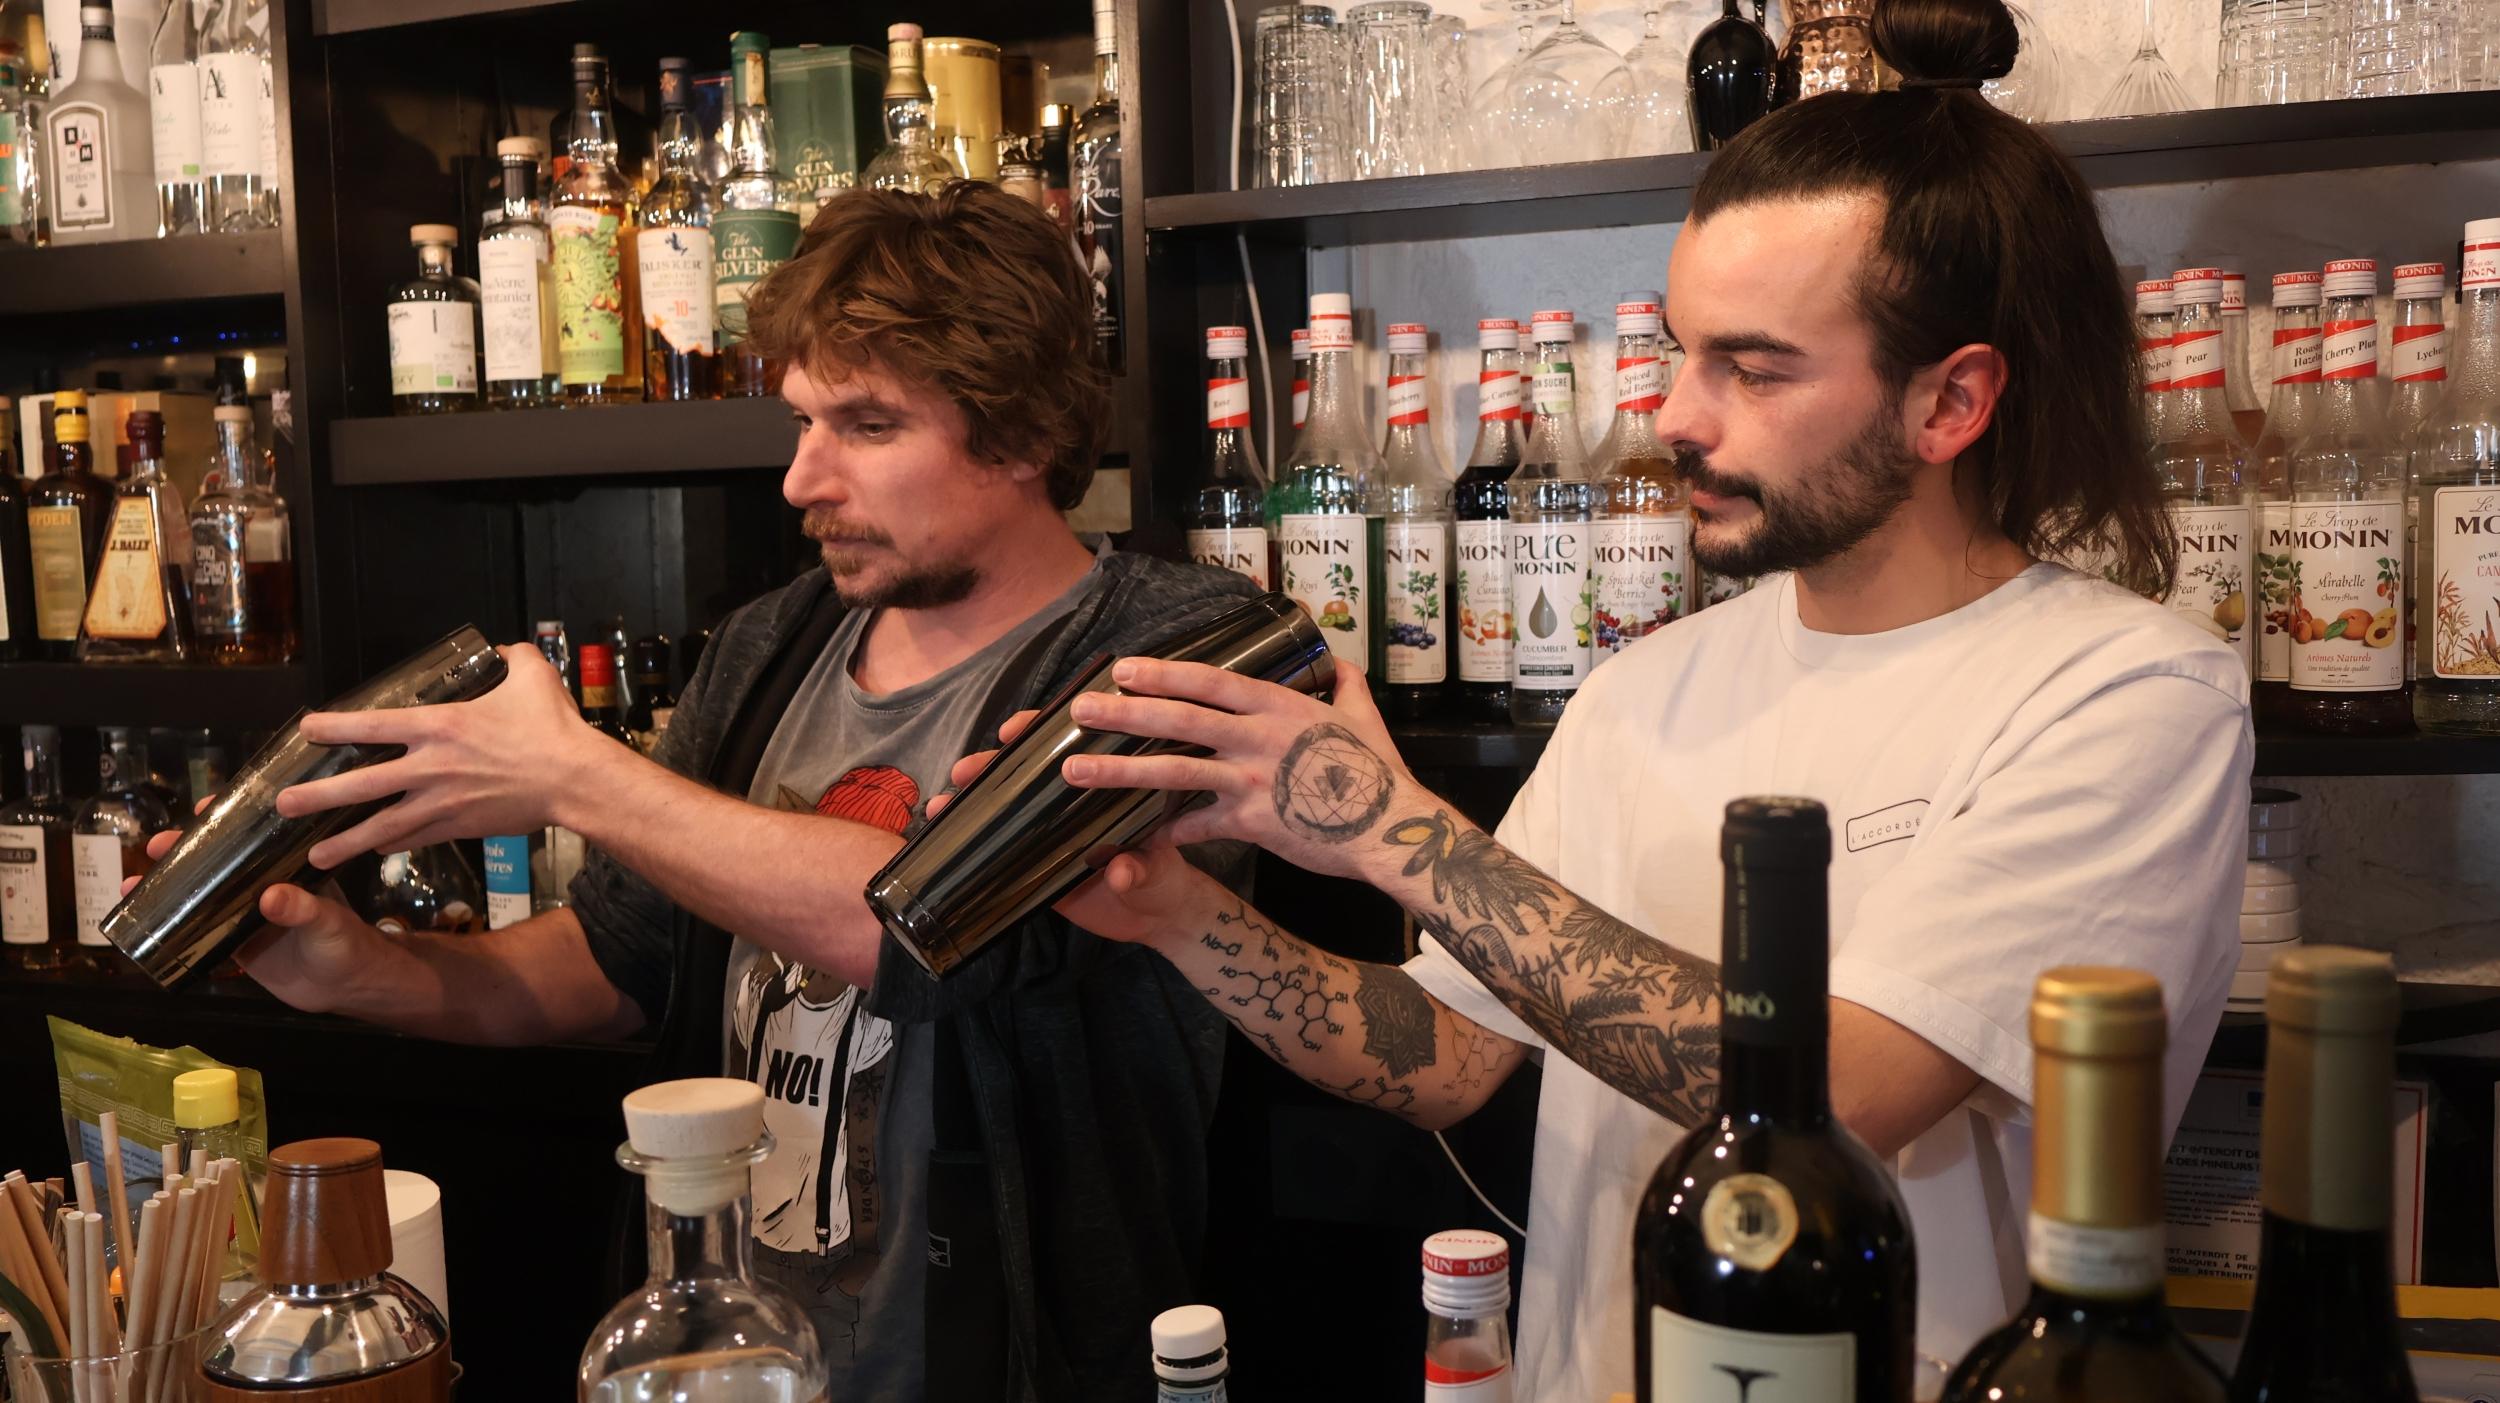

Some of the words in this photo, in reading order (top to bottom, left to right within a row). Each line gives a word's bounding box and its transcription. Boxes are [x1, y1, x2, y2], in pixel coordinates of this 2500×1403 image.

[794, 161, 834, 177] GLEN
[721, 246, 764, 260] GLEN
[2331, 261, 2373, 272] MONIN
[2222, 296, 2242, 305] NIN
[2186, 352, 2209, 365] Pear
[2325, 346, 2355, 361] Cherry
[1624, 369, 1651, 384] Spiced
[2211, 521, 2229, 533] de
[2300, 511, 2318, 528] Le
[2319, 510, 2360, 531] Sirop
[2361, 515, 2379, 527] de
[2181, 534, 2238, 554] NIN
[2293, 528, 2390, 549] MONIN
[1281, 538, 1350, 557] MONIN
[1458, 544, 1508, 562] MON
[1593, 544, 1675, 564] MONIN
[1387, 547, 1431, 564] NIN
[1513, 561, 1577, 577] MONIN
[2313, 569, 2368, 591] Mirabelle
[1522, 645, 1568, 654] CUCUMBER
[2336, 652, 2372, 663] Naturels
[1217, 965, 1238, 979] HO
[1334, 991, 1349, 1005] OH
[1327, 1022, 1345, 1037] OH
[1303, 1040, 1322, 1053] OH
[765, 1047, 825, 1108] NO!
[2175, 1156, 2200, 1168] DES
[2200, 1158, 2253, 1173] MINEURS
[2185, 1248, 2230, 1260] INTERDIT
[2234, 1254, 2249, 1262] DE
